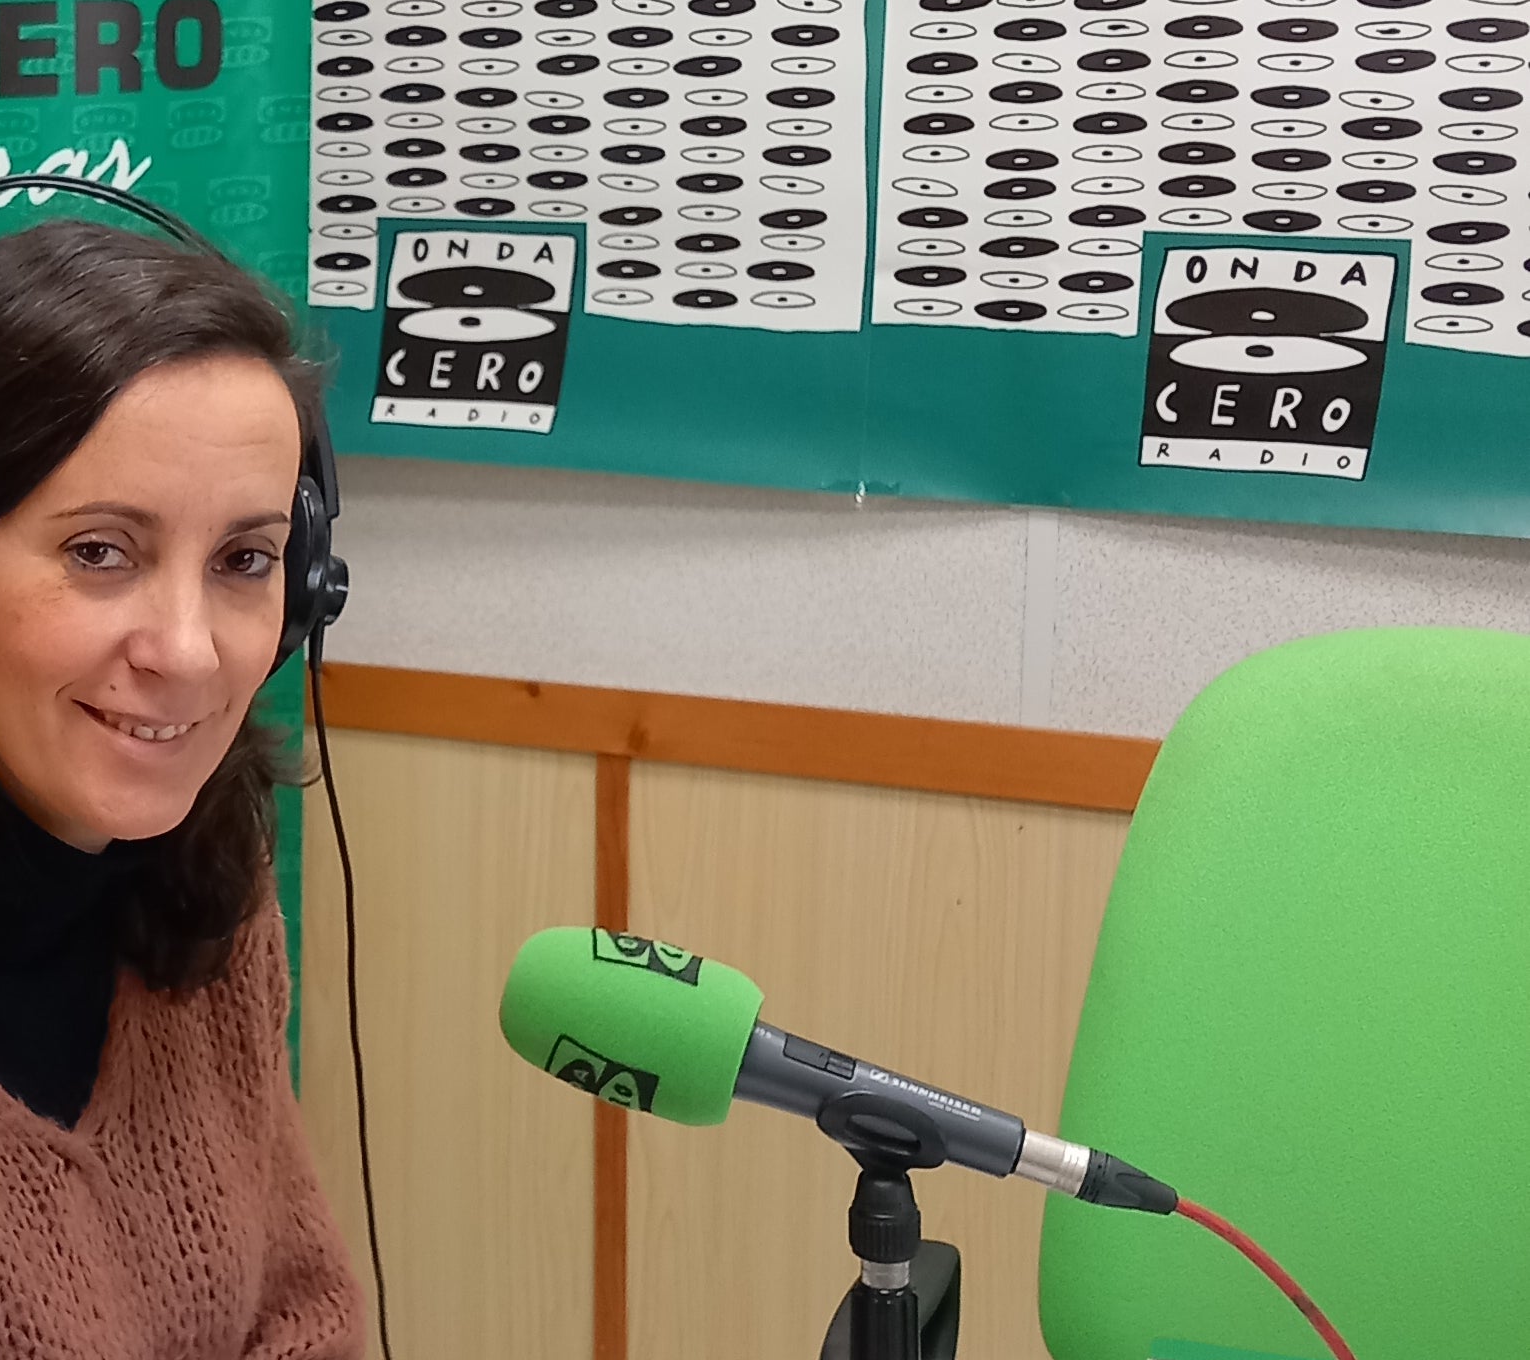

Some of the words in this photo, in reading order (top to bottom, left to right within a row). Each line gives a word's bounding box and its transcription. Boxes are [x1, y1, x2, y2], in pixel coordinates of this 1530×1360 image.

[413, 238, 555, 264] ONDA
[1185, 255, 1368, 287] ONDA
[385, 348, 546, 394] CERO
[384, 402, 543, 427] RADIO
[1155, 381, 1352, 434] CERO
[1156, 443, 1352, 470] RADIO
[891, 1077, 982, 1117] SENNHEISER
